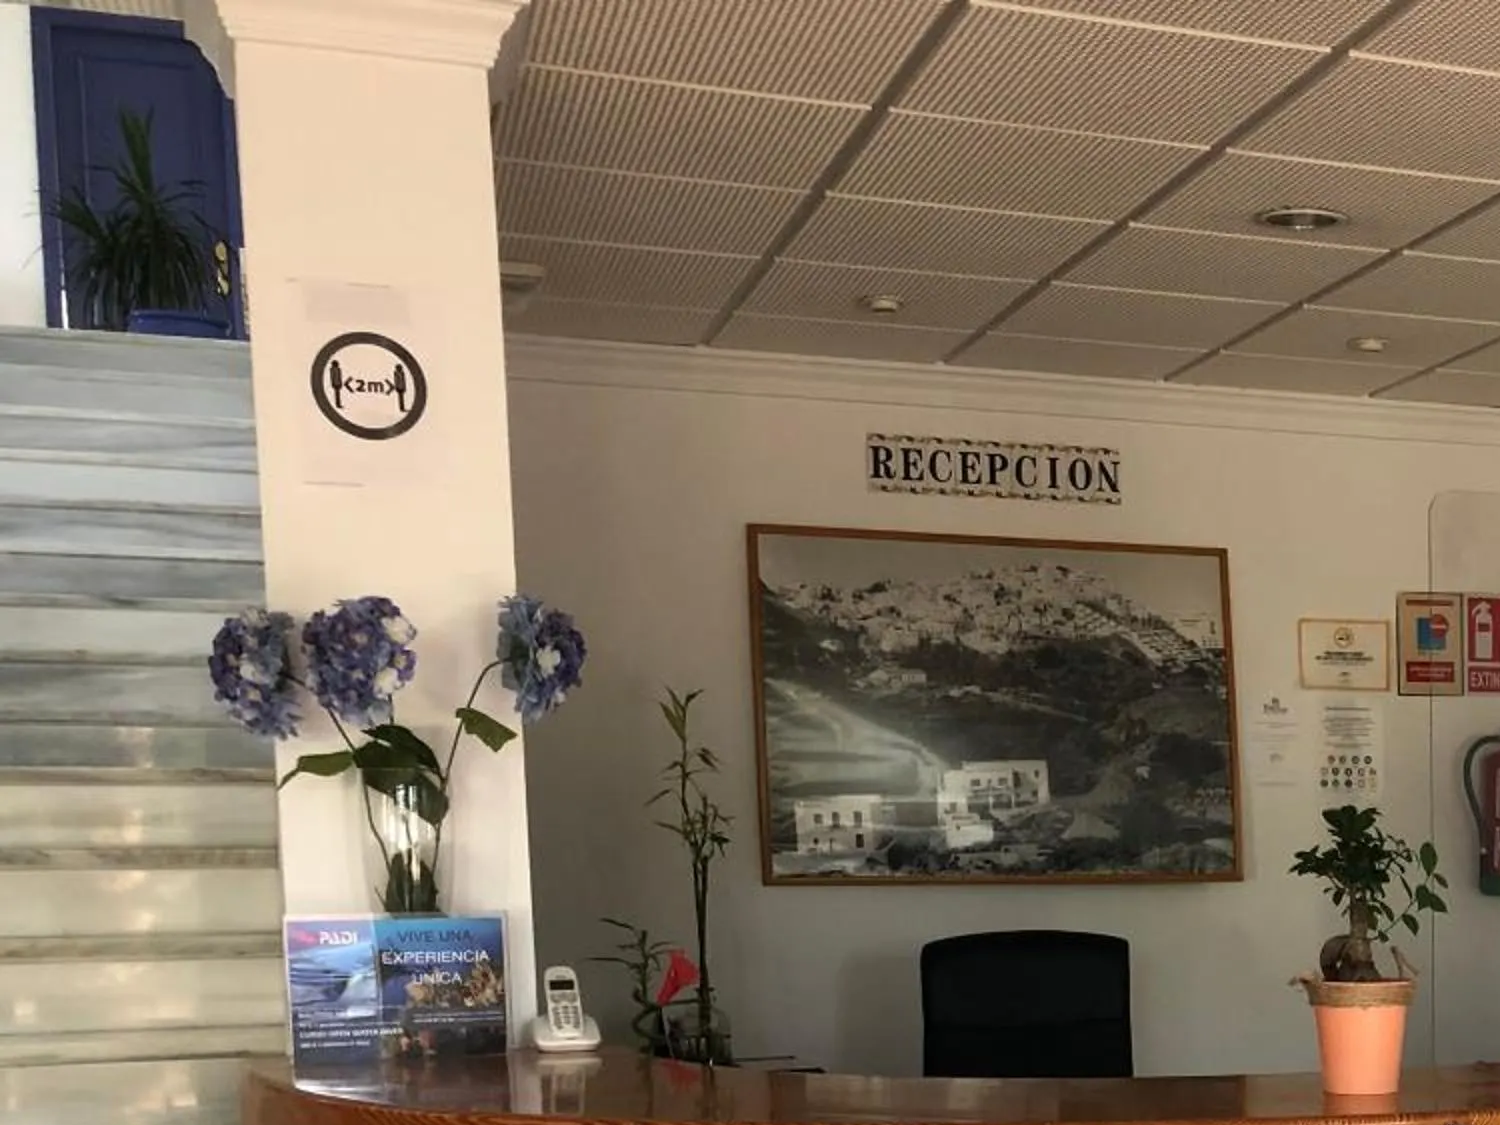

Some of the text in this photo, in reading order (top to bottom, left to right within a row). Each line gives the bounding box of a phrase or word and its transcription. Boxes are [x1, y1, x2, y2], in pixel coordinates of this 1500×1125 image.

[869, 445, 1121, 493] RECEPCION
[319, 930, 359, 945] PADI
[399, 929, 473, 944] VIVE UNA
[382, 949, 490, 965] EXPERIENCIA
